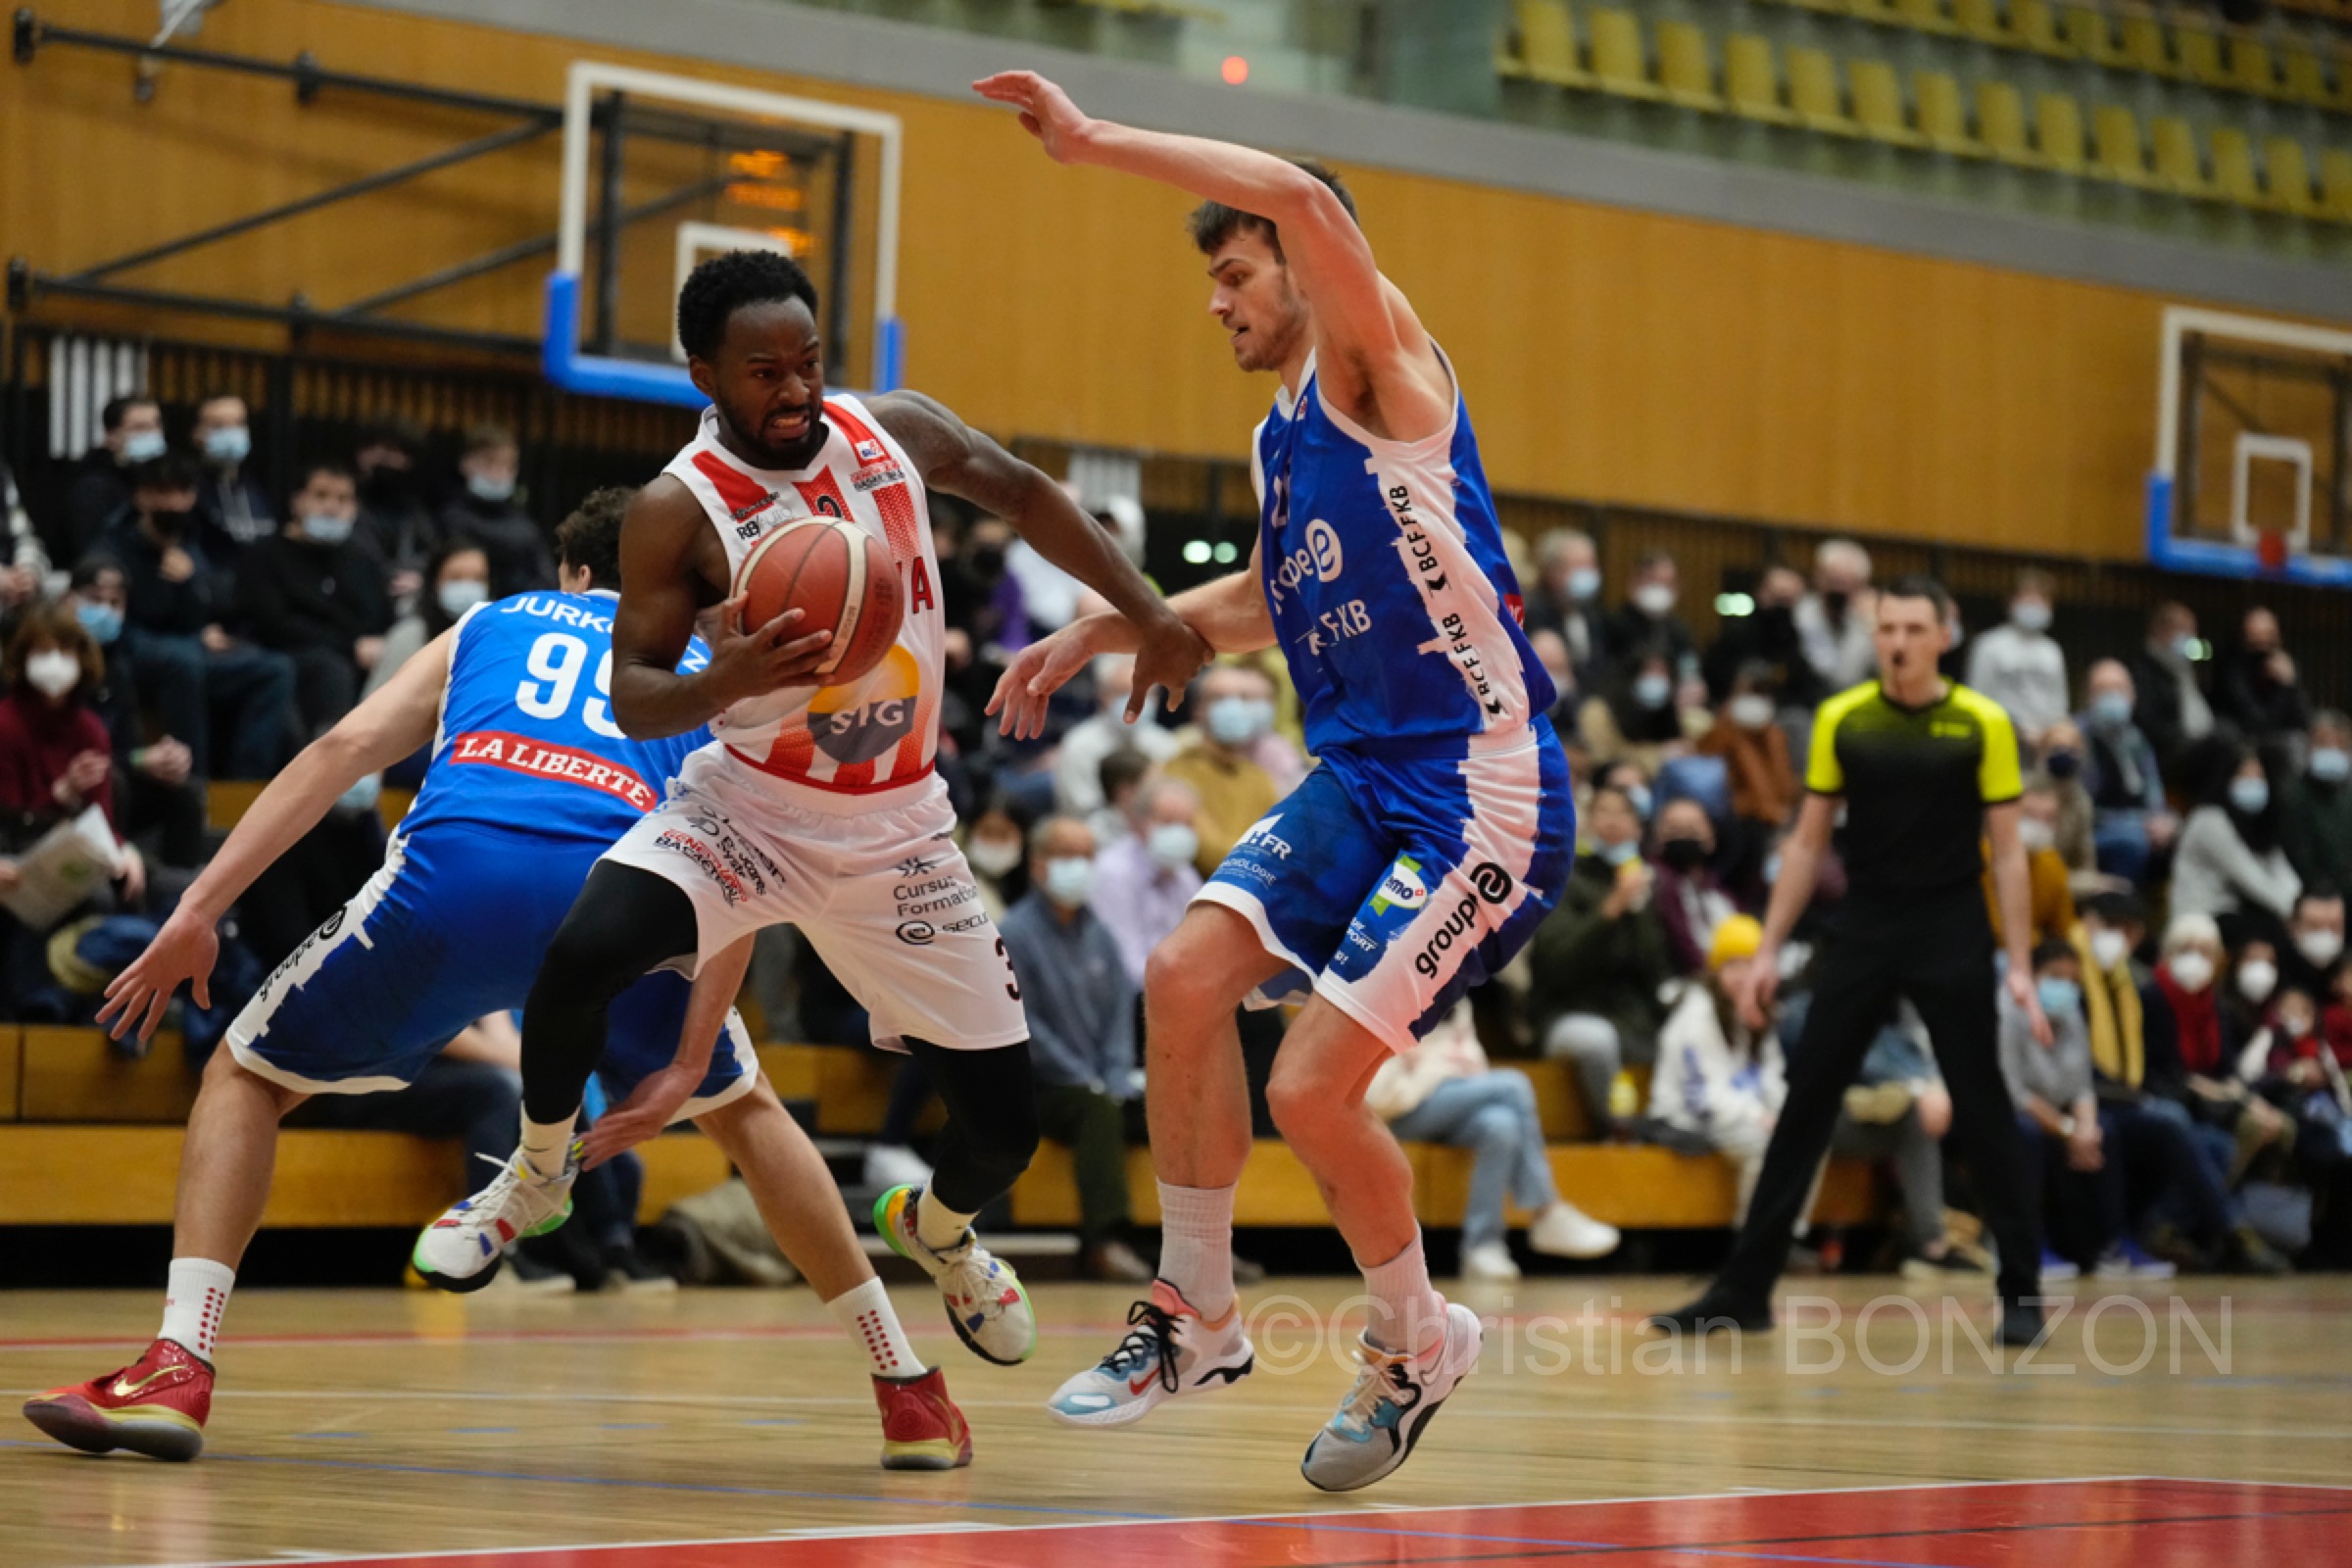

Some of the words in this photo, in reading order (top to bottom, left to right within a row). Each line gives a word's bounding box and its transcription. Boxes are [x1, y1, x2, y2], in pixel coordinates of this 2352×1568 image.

[501, 597, 612, 634] JURK
[458, 737, 504, 760] LA
[507, 743, 652, 808] LIBERTE
